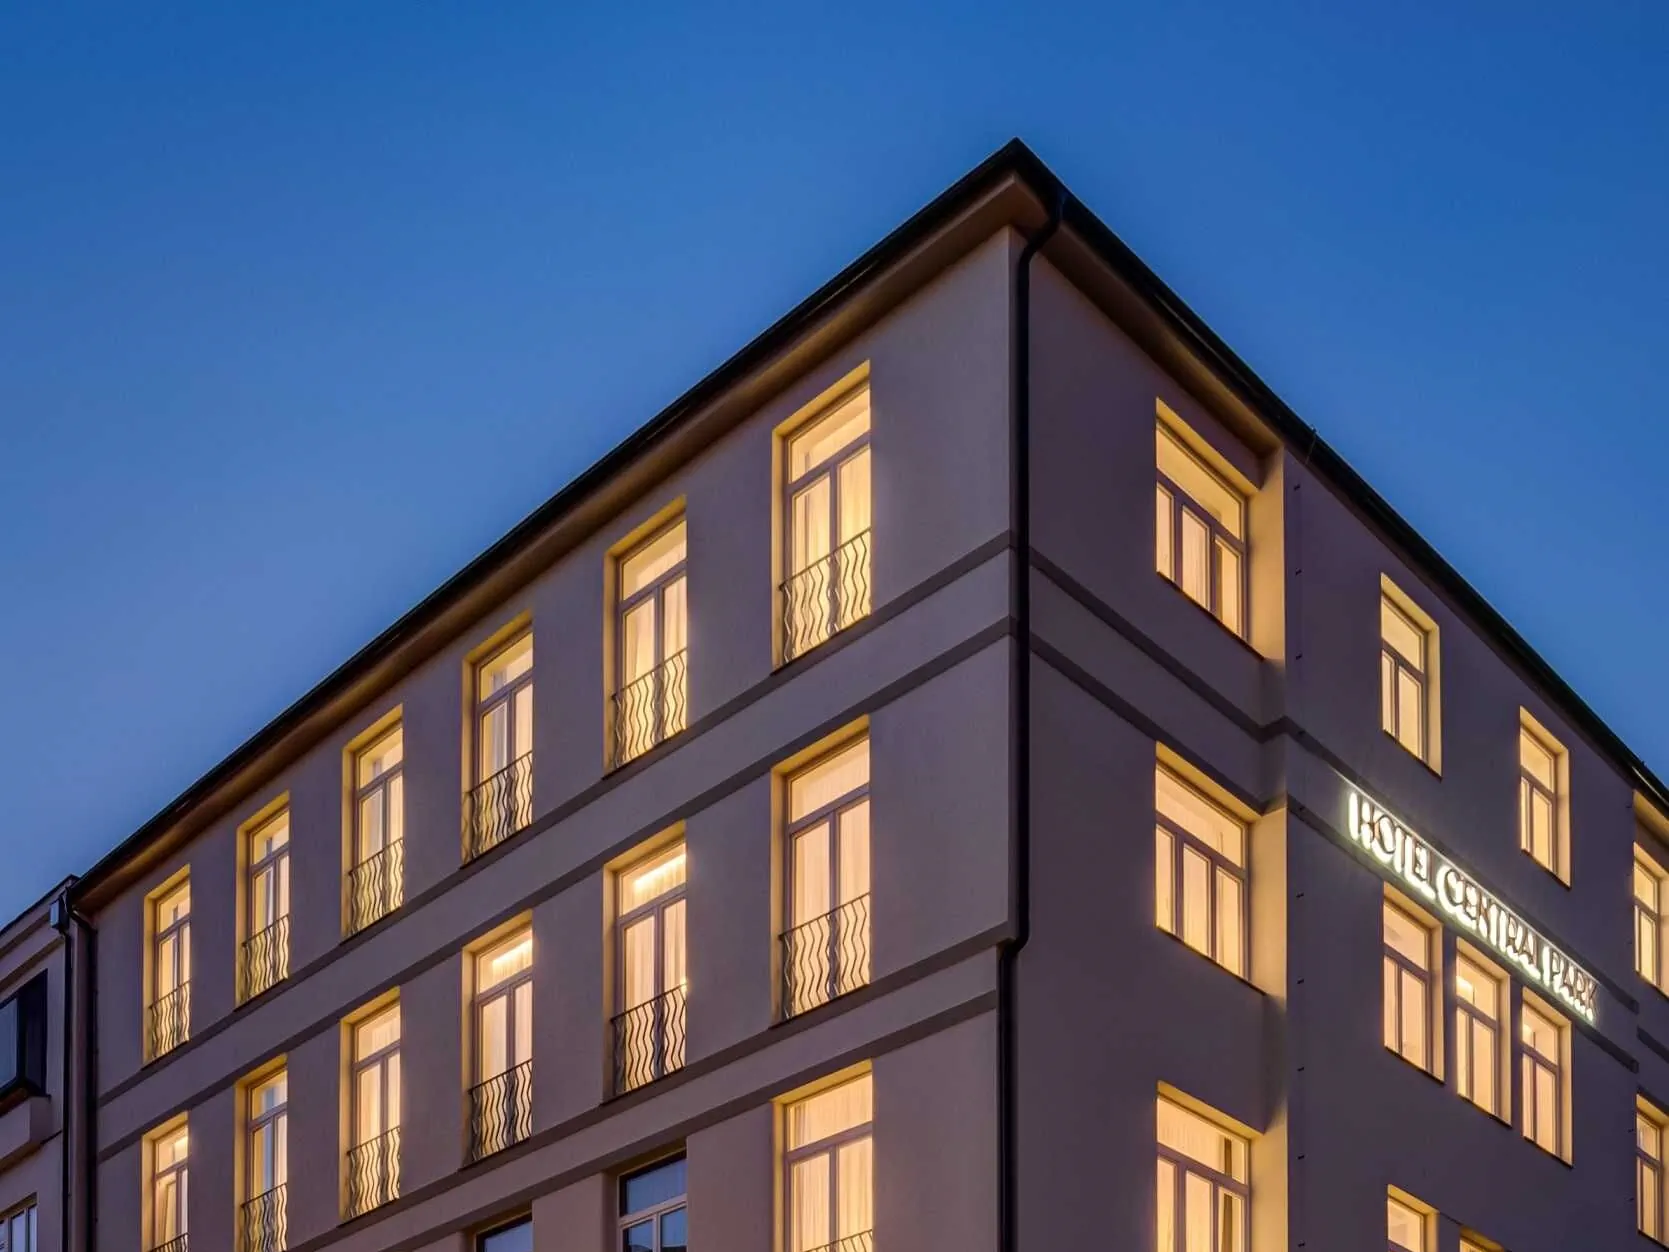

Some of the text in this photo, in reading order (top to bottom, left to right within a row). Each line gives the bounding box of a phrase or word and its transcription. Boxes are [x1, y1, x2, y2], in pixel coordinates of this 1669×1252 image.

[1348, 791, 1599, 1024] HOTEL CENTRAL PARK
